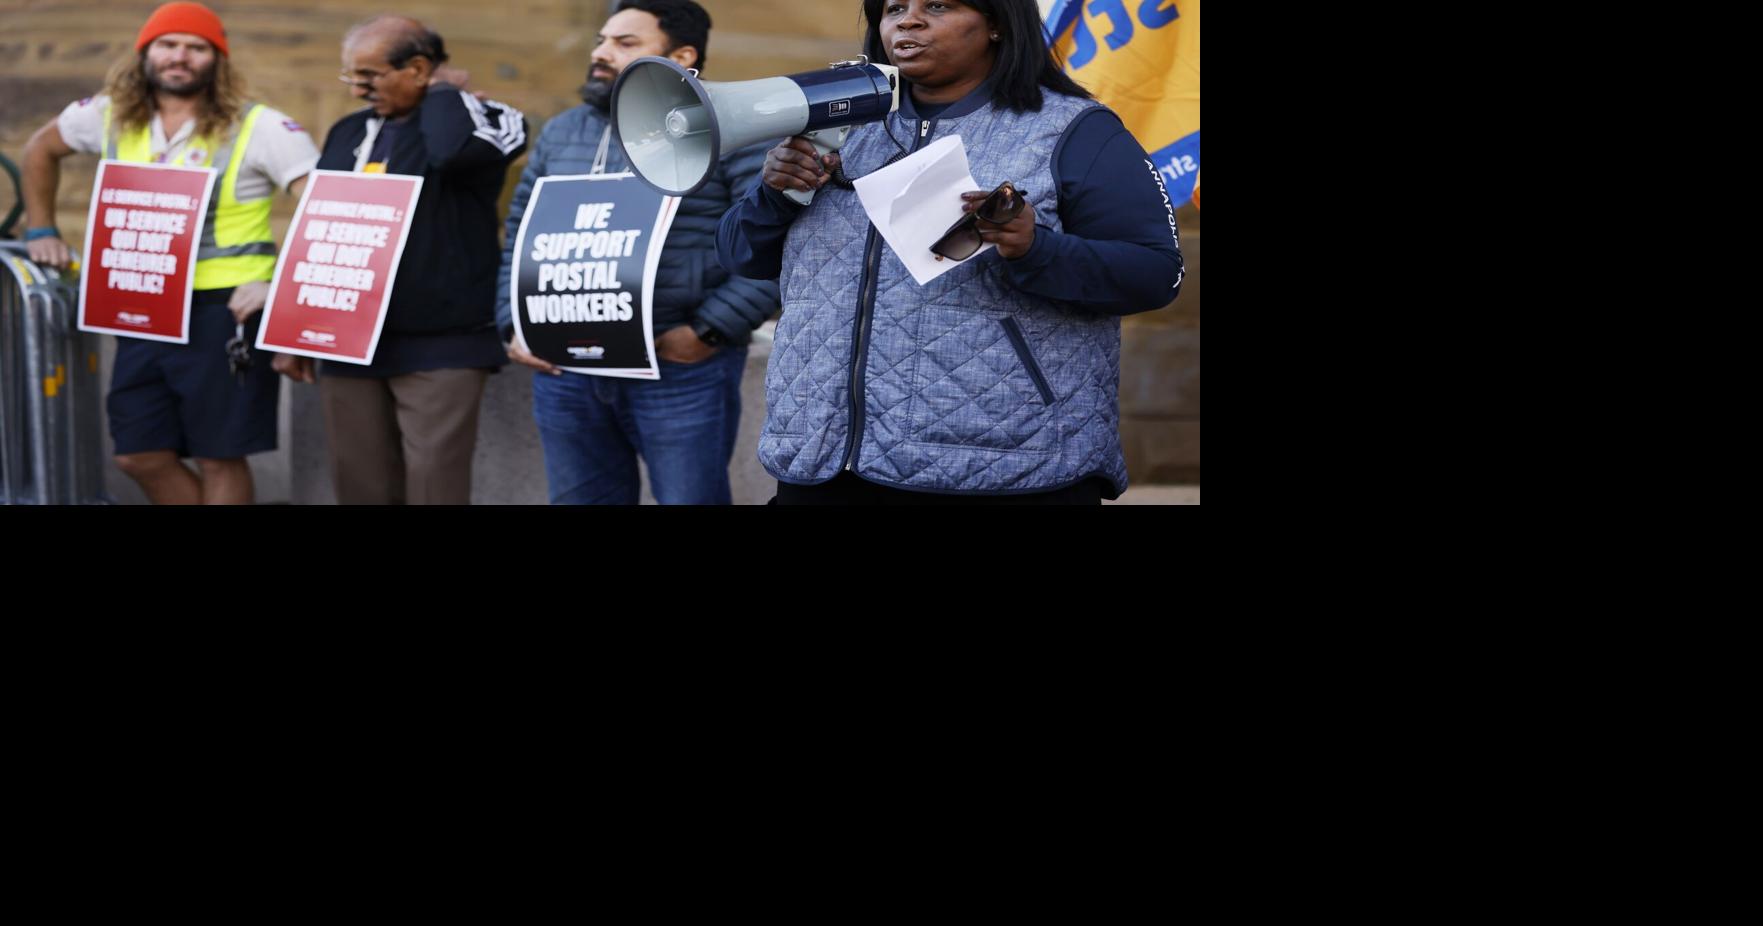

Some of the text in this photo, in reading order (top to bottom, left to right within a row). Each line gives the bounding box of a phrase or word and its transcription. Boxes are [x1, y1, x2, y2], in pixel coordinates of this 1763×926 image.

[104, 207, 187, 235] UN SERVICE
[574, 202, 615, 230] WE
[111, 229, 174, 253] QUI DOIT
[304, 219, 391, 248] UN SERVICE
[531, 229, 641, 262] SUPPORT
[101, 248, 177, 275] DEMEURER
[307, 241, 375, 268] QUI DOIT
[108, 269, 165, 294] PUBLIC!
[293, 261, 375, 292] DEMEURER
[538, 260, 622, 292] POSTAL
[296, 283, 360, 312] PUBLIC!
[525, 291, 634, 324] WORKERS
